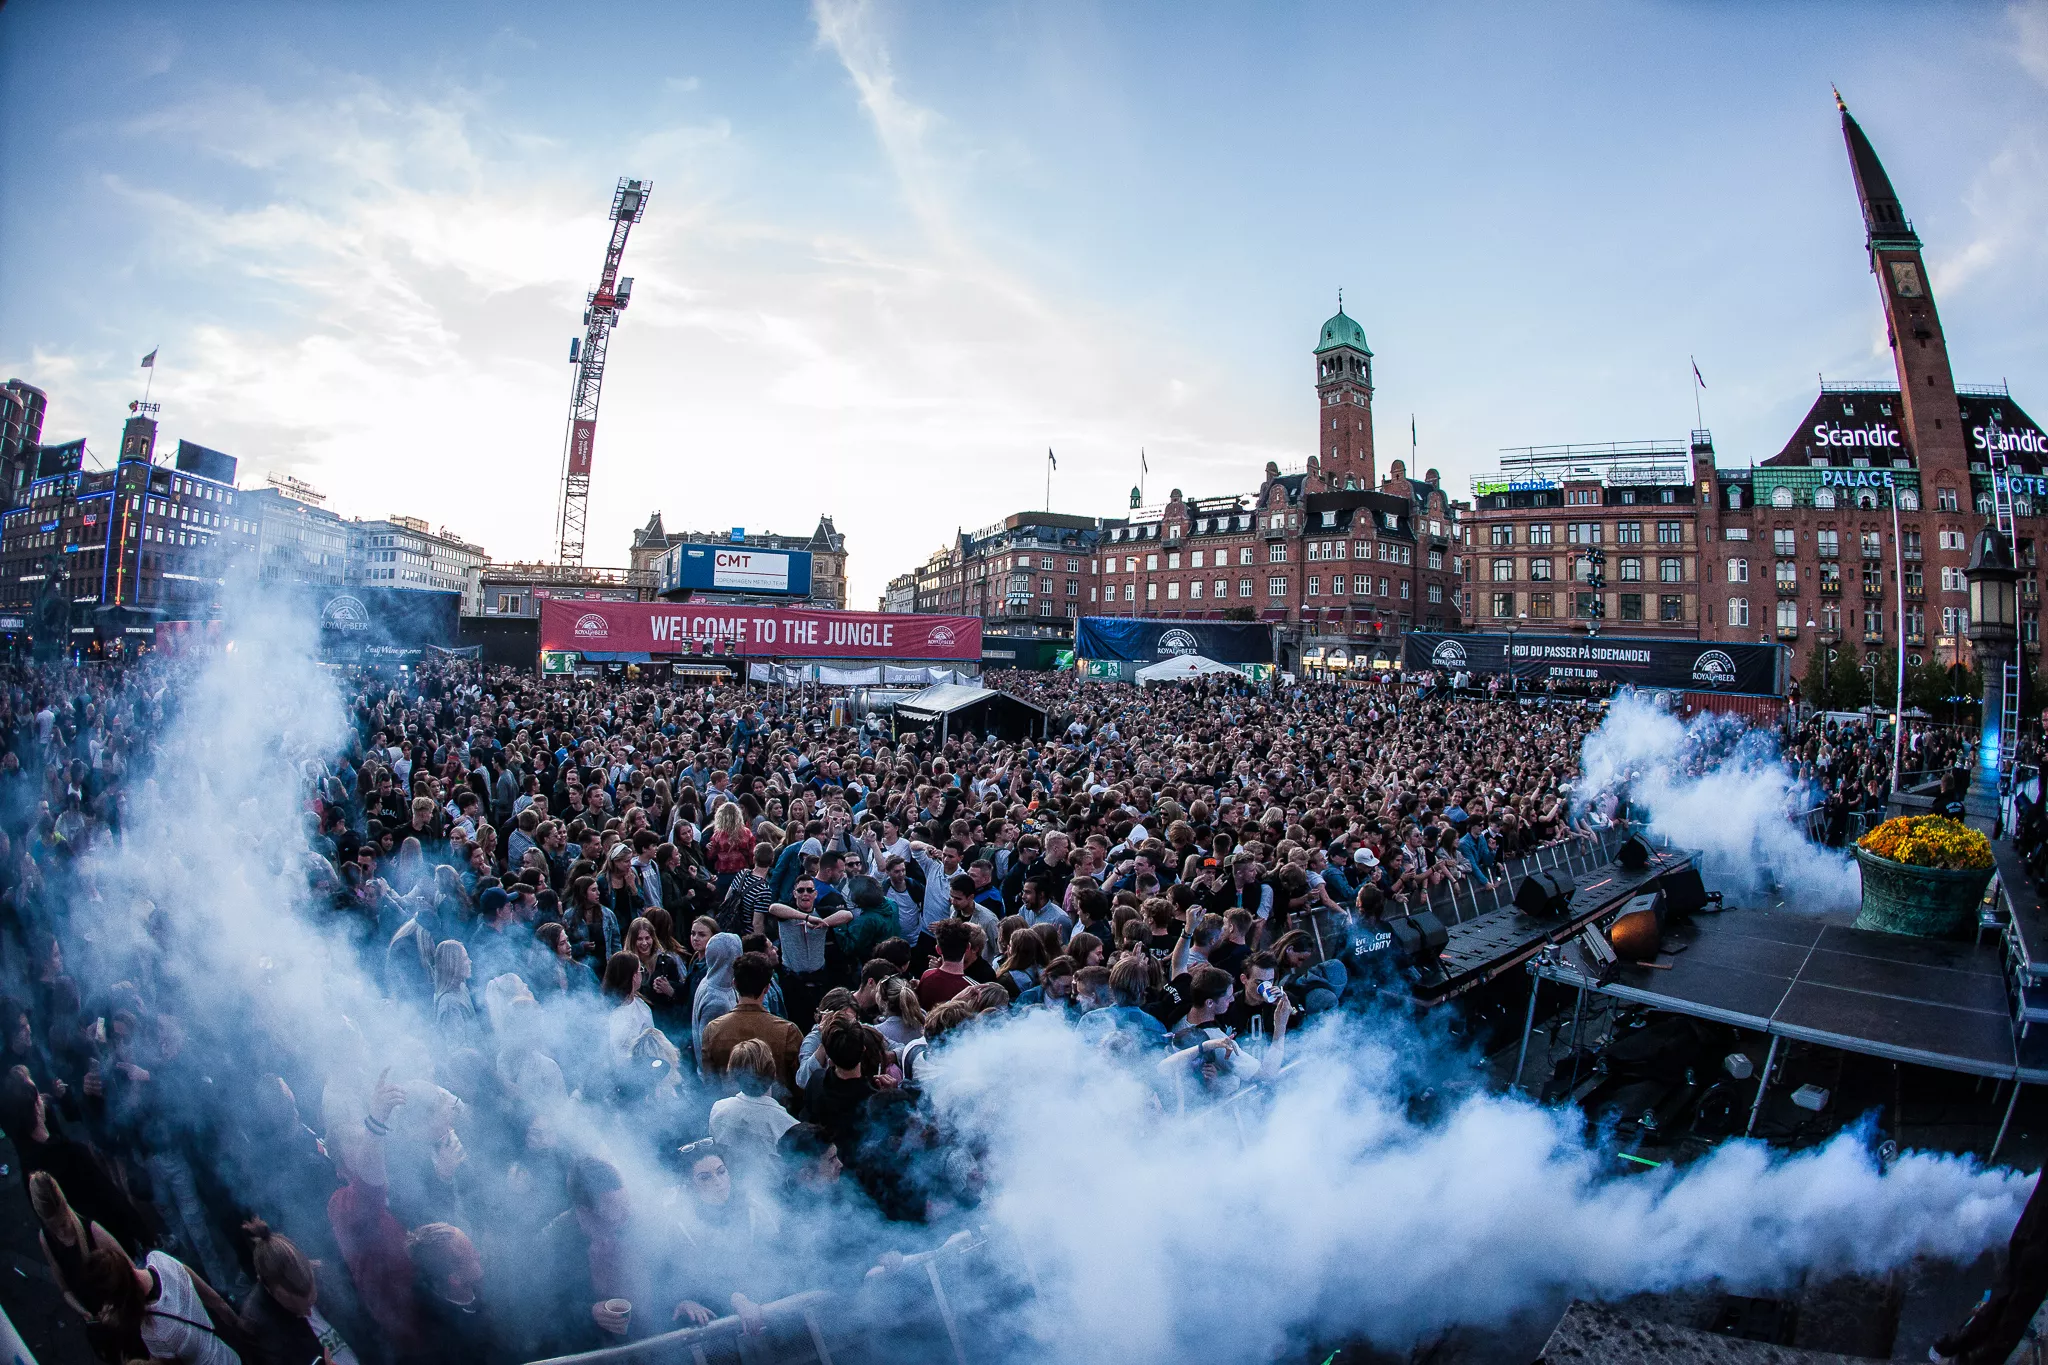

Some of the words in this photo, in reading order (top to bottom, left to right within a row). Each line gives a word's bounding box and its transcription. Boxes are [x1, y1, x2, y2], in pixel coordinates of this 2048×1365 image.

[139, 402, 161, 412] THAI
[1814, 424, 1901, 447] Scandic
[1821, 470, 1895, 488] PALACE
[1476, 478, 1556, 496] Lycamobile
[716, 553, 752, 568] CMT
[715, 577, 752, 585] COPENHAGEN
[320, 620, 343, 631] ROYAL
[349, 621, 369, 631] BEER
[650, 615, 748, 642] WELCOME
[752, 617, 777, 644] TO
[782, 619, 819, 645] THE
[823, 621, 894, 647] JUNGLE
[1503, 644, 1529, 657] FRDI
[1531, 645, 1544, 657] DU
[1545, 646, 1577, 659] PASSER
[1578, 644, 1591, 659] PÅ
[1591, 648, 1650, 662] SIDEMANDEN
[1432, 658, 1448, 666] ROYAL
[1452, 659, 1467, 667] BEER
[1550, 667, 1563, 677] DEN
[1564, 668, 1573, 677] ER
[1574, 669, 1584, 678] TIL
[1585, 670, 1598, 679] DIG
[1692, 672, 1712, 681] ROYAL
[1718, 673, 1736, 682] BEER
[1375, 932, 1392, 941] CREW
[1354, 940, 1392, 956] SECURITY
